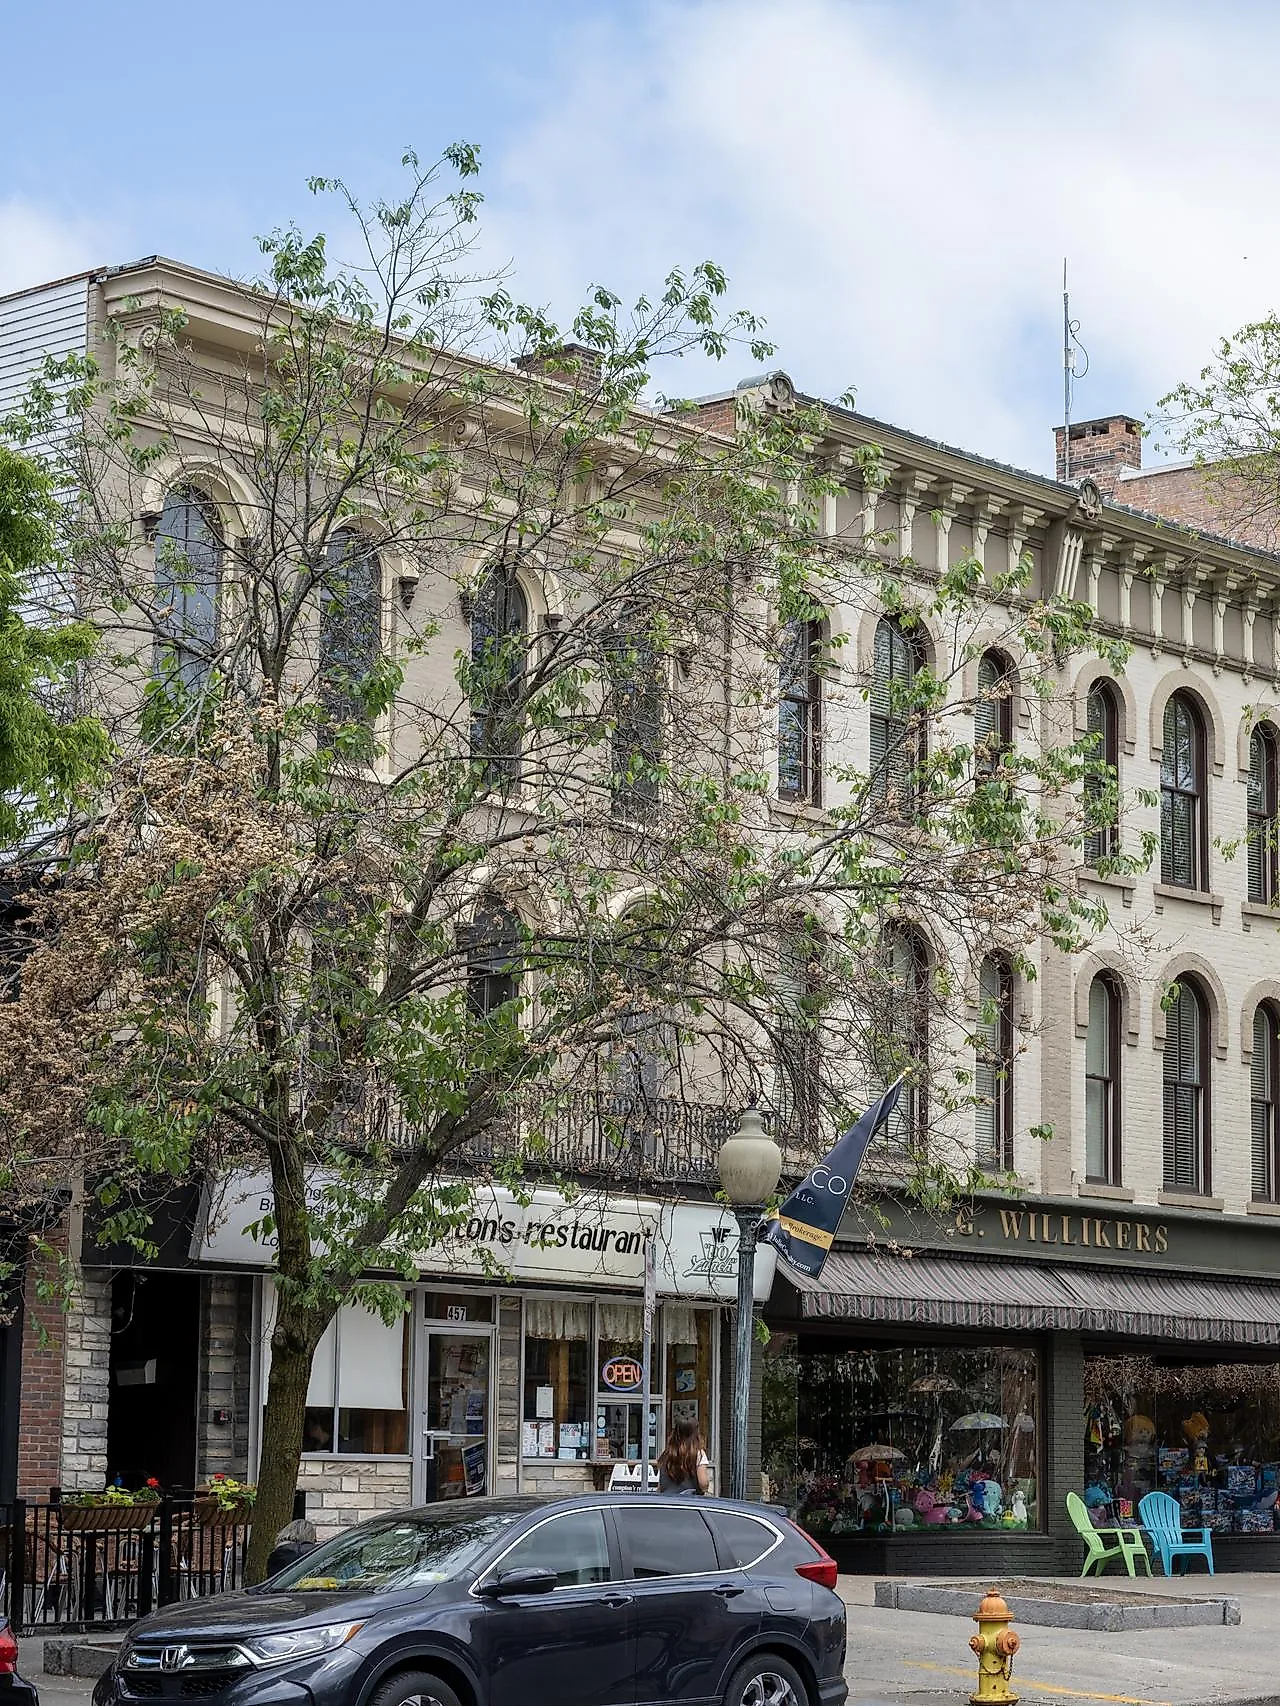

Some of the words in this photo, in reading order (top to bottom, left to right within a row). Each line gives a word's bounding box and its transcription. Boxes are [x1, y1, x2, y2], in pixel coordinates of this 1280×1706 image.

[525, 1219, 653, 1255] restaurant
[1000, 1209, 1168, 1253] WILLIKERS
[448, 1306, 466, 1321] 457
[604, 1364, 641, 1383] OPEN
